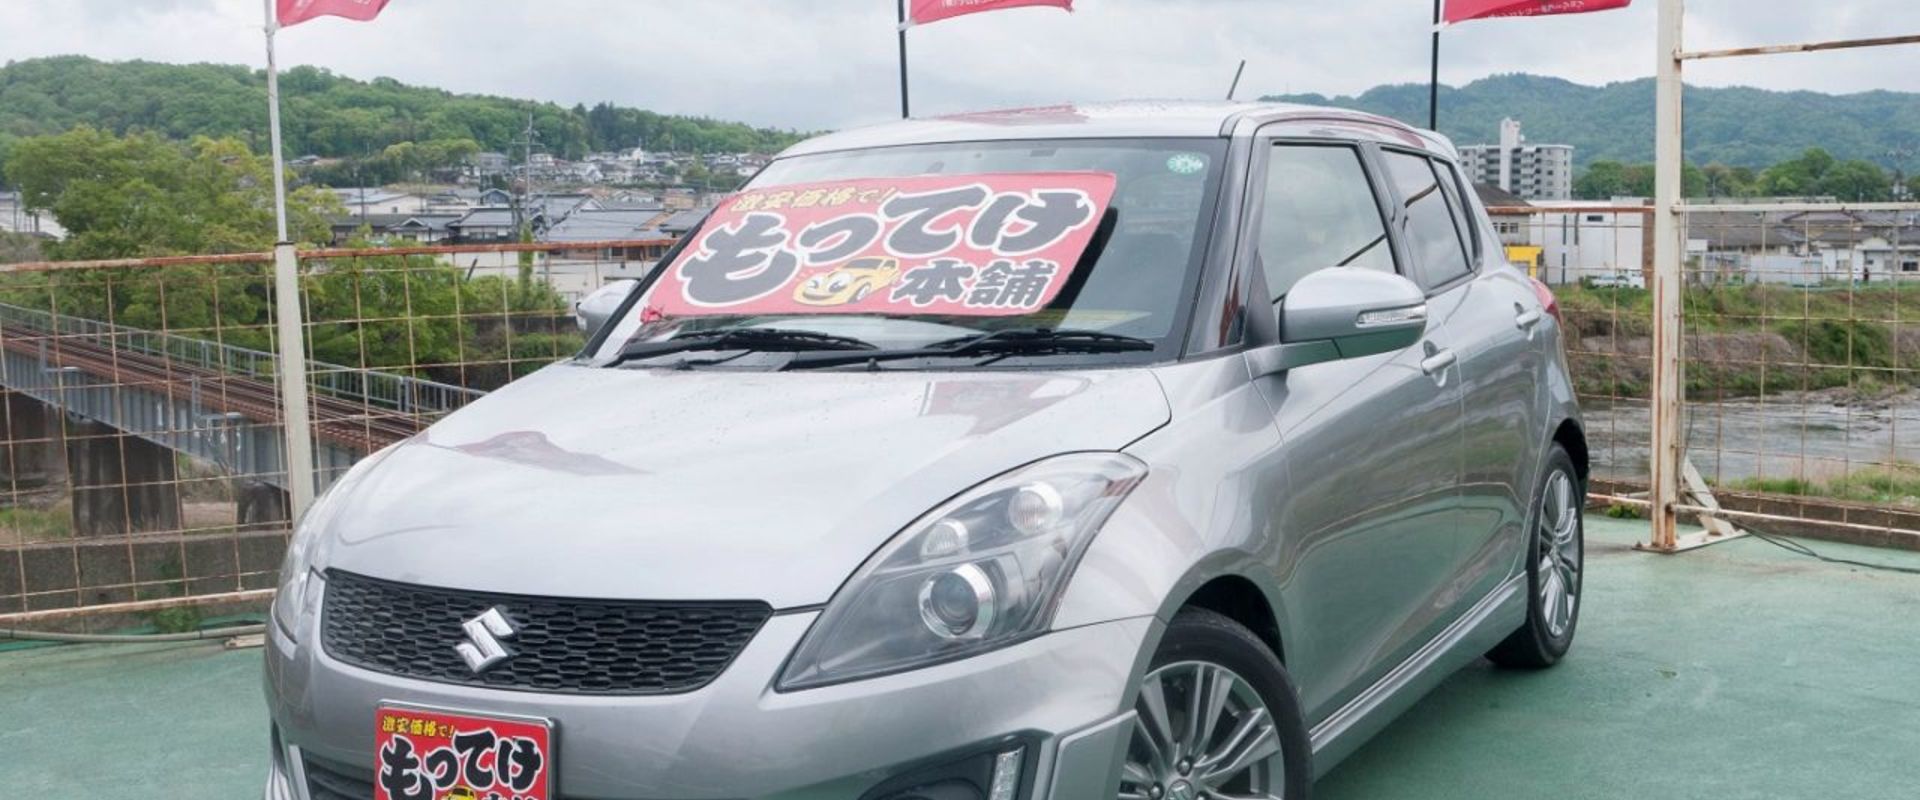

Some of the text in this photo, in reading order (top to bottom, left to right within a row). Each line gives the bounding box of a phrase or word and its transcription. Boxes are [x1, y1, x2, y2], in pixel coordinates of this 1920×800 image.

[676, 183, 1096, 306] もってけ
[889, 257, 1060, 309] 本舗
[379, 727, 544, 800] もってけ
